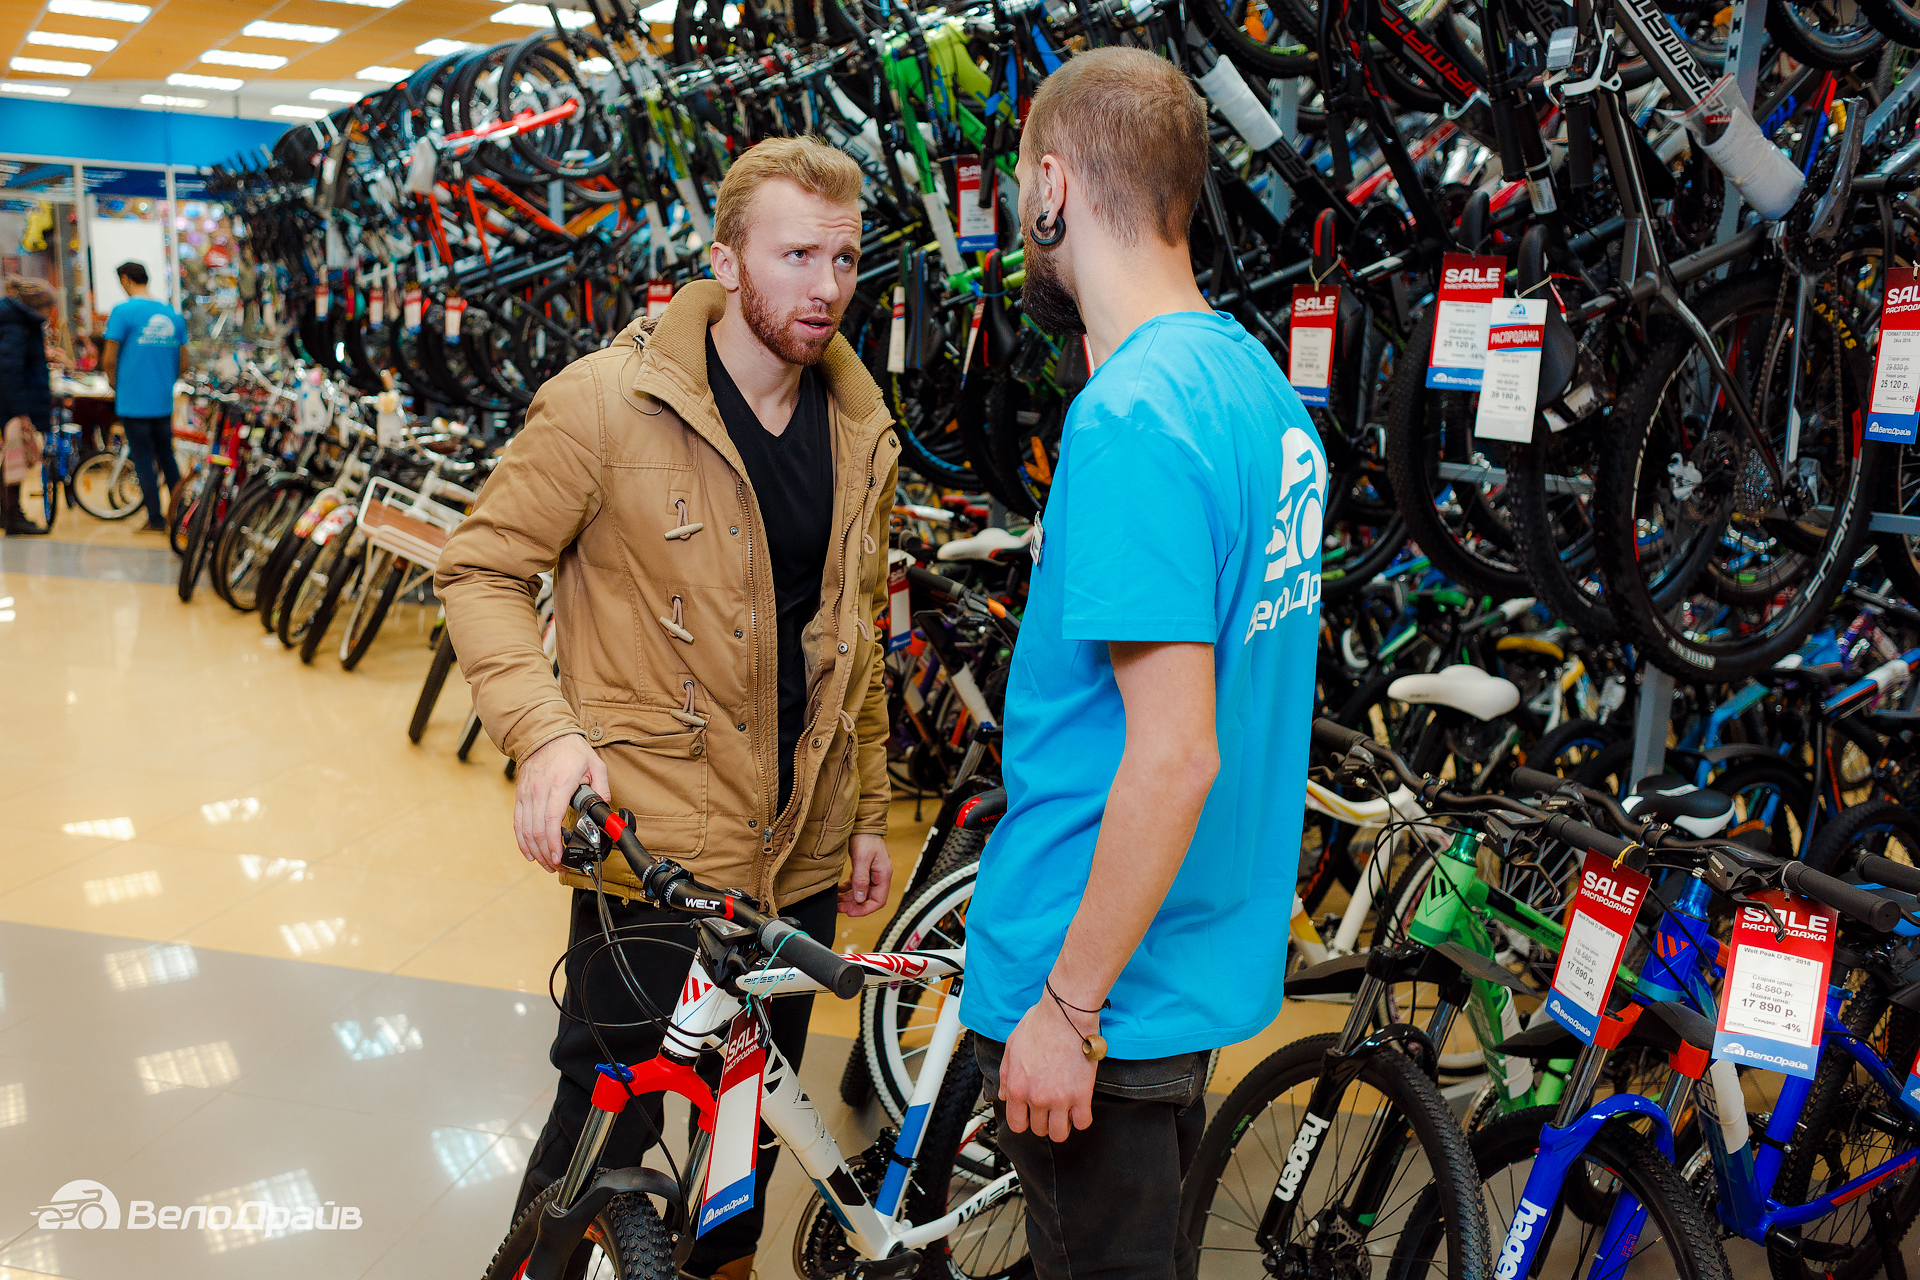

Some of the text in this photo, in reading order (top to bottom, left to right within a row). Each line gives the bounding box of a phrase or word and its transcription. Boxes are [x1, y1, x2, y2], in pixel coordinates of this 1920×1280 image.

[1631, 0, 1723, 112] ORMAT
[1444, 267, 1501, 283] SALE
[1295, 295, 1336, 311] SALE
[1885, 304, 1920, 315] РАСПРОДА
[1814, 298, 1857, 349] AXXIS
[1491, 330, 1539, 345] РАСПРОДАЖА
[1880, 379, 1910, 390] 25 120 р.
[1899, 395, 1915, 403] -16%
[1879, 426, 1912, 436] ВелоДрайв
[1583, 871, 1640, 907] SALE
[685, 898, 720, 910] WELT
[1580, 888, 1633, 916] РАСПРОДАЖА
[1741, 922, 1827, 942] РАСПОДАЖА
[1744, 947, 1758, 955] Welt
[1759, 950, 1775, 958] Peak
[1795, 958, 1811, 966] 2018
[1567, 961, 1595, 987] 17 890 р.
[1752, 974, 1794, 988] Старая цена:
[1750, 982, 1793, 998] 18 580 р.
[1750, 992, 1791, 1005] Новая цена:
[1741, 998, 1797, 1018] 17 890 р.
[1560, 1009, 1591, 1037] ВелоДрайв
[1753, 1017, 1777, 1026] Скидка:
[1781, 1023, 1801, 1033] -4%
[727, 1021, 761, 1063] SALE
[724, 1043, 760, 1076] РАСПРОДАЖ
[1745, 1049, 1809, 1070] ВелоДрайв
[1274, 1111, 1331, 1202] hagen
[714, 1194, 749, 1219] ВелоДрайв
